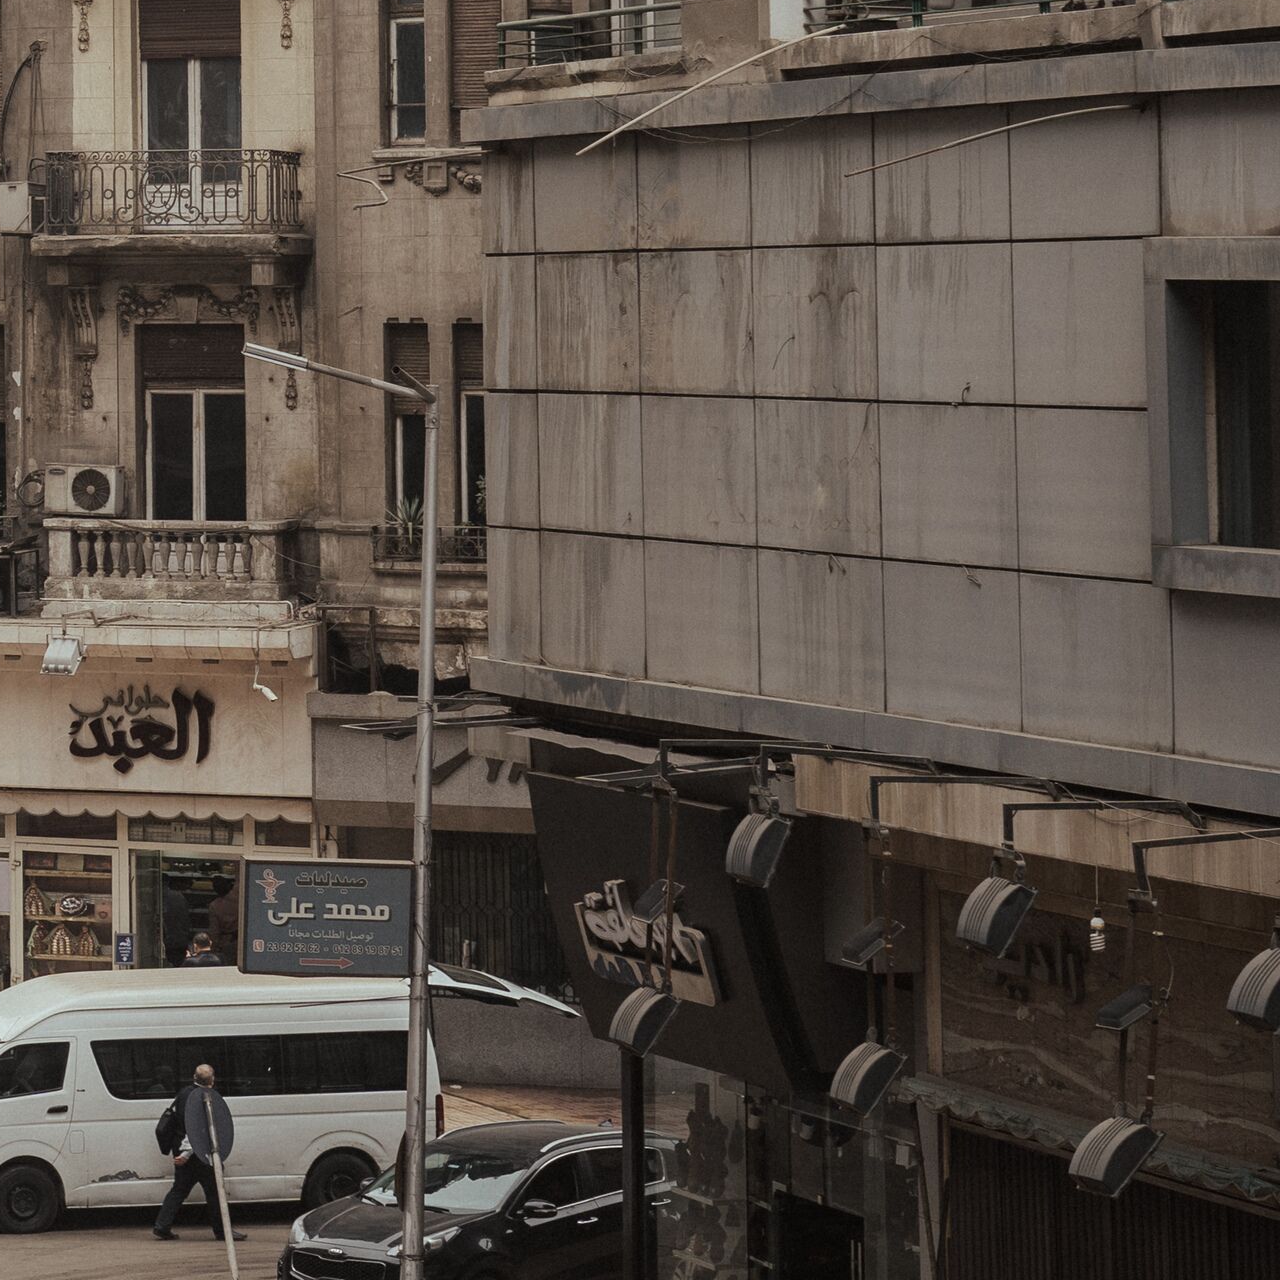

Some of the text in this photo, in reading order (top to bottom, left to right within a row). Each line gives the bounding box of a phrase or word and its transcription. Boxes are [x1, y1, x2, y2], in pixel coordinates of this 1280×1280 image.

[68, 687, 216, 774] العبد
[295, 871, 368, 894] صيدليات
[267, 897, 390, 926] محمد على
[311, 929, 345, 941] الطلبات
[347, 931, 374, 942] توصيل
[266, 942, 279, 952] 23
[281, 942, 293, 952] 92
[294, 943, 306, 952] 52
[333, 944, 349, 954] 012
[351, 944, 363, 955] 89
[365, 945, 377, 955] 19
[378, 945, 390, 955] 87
